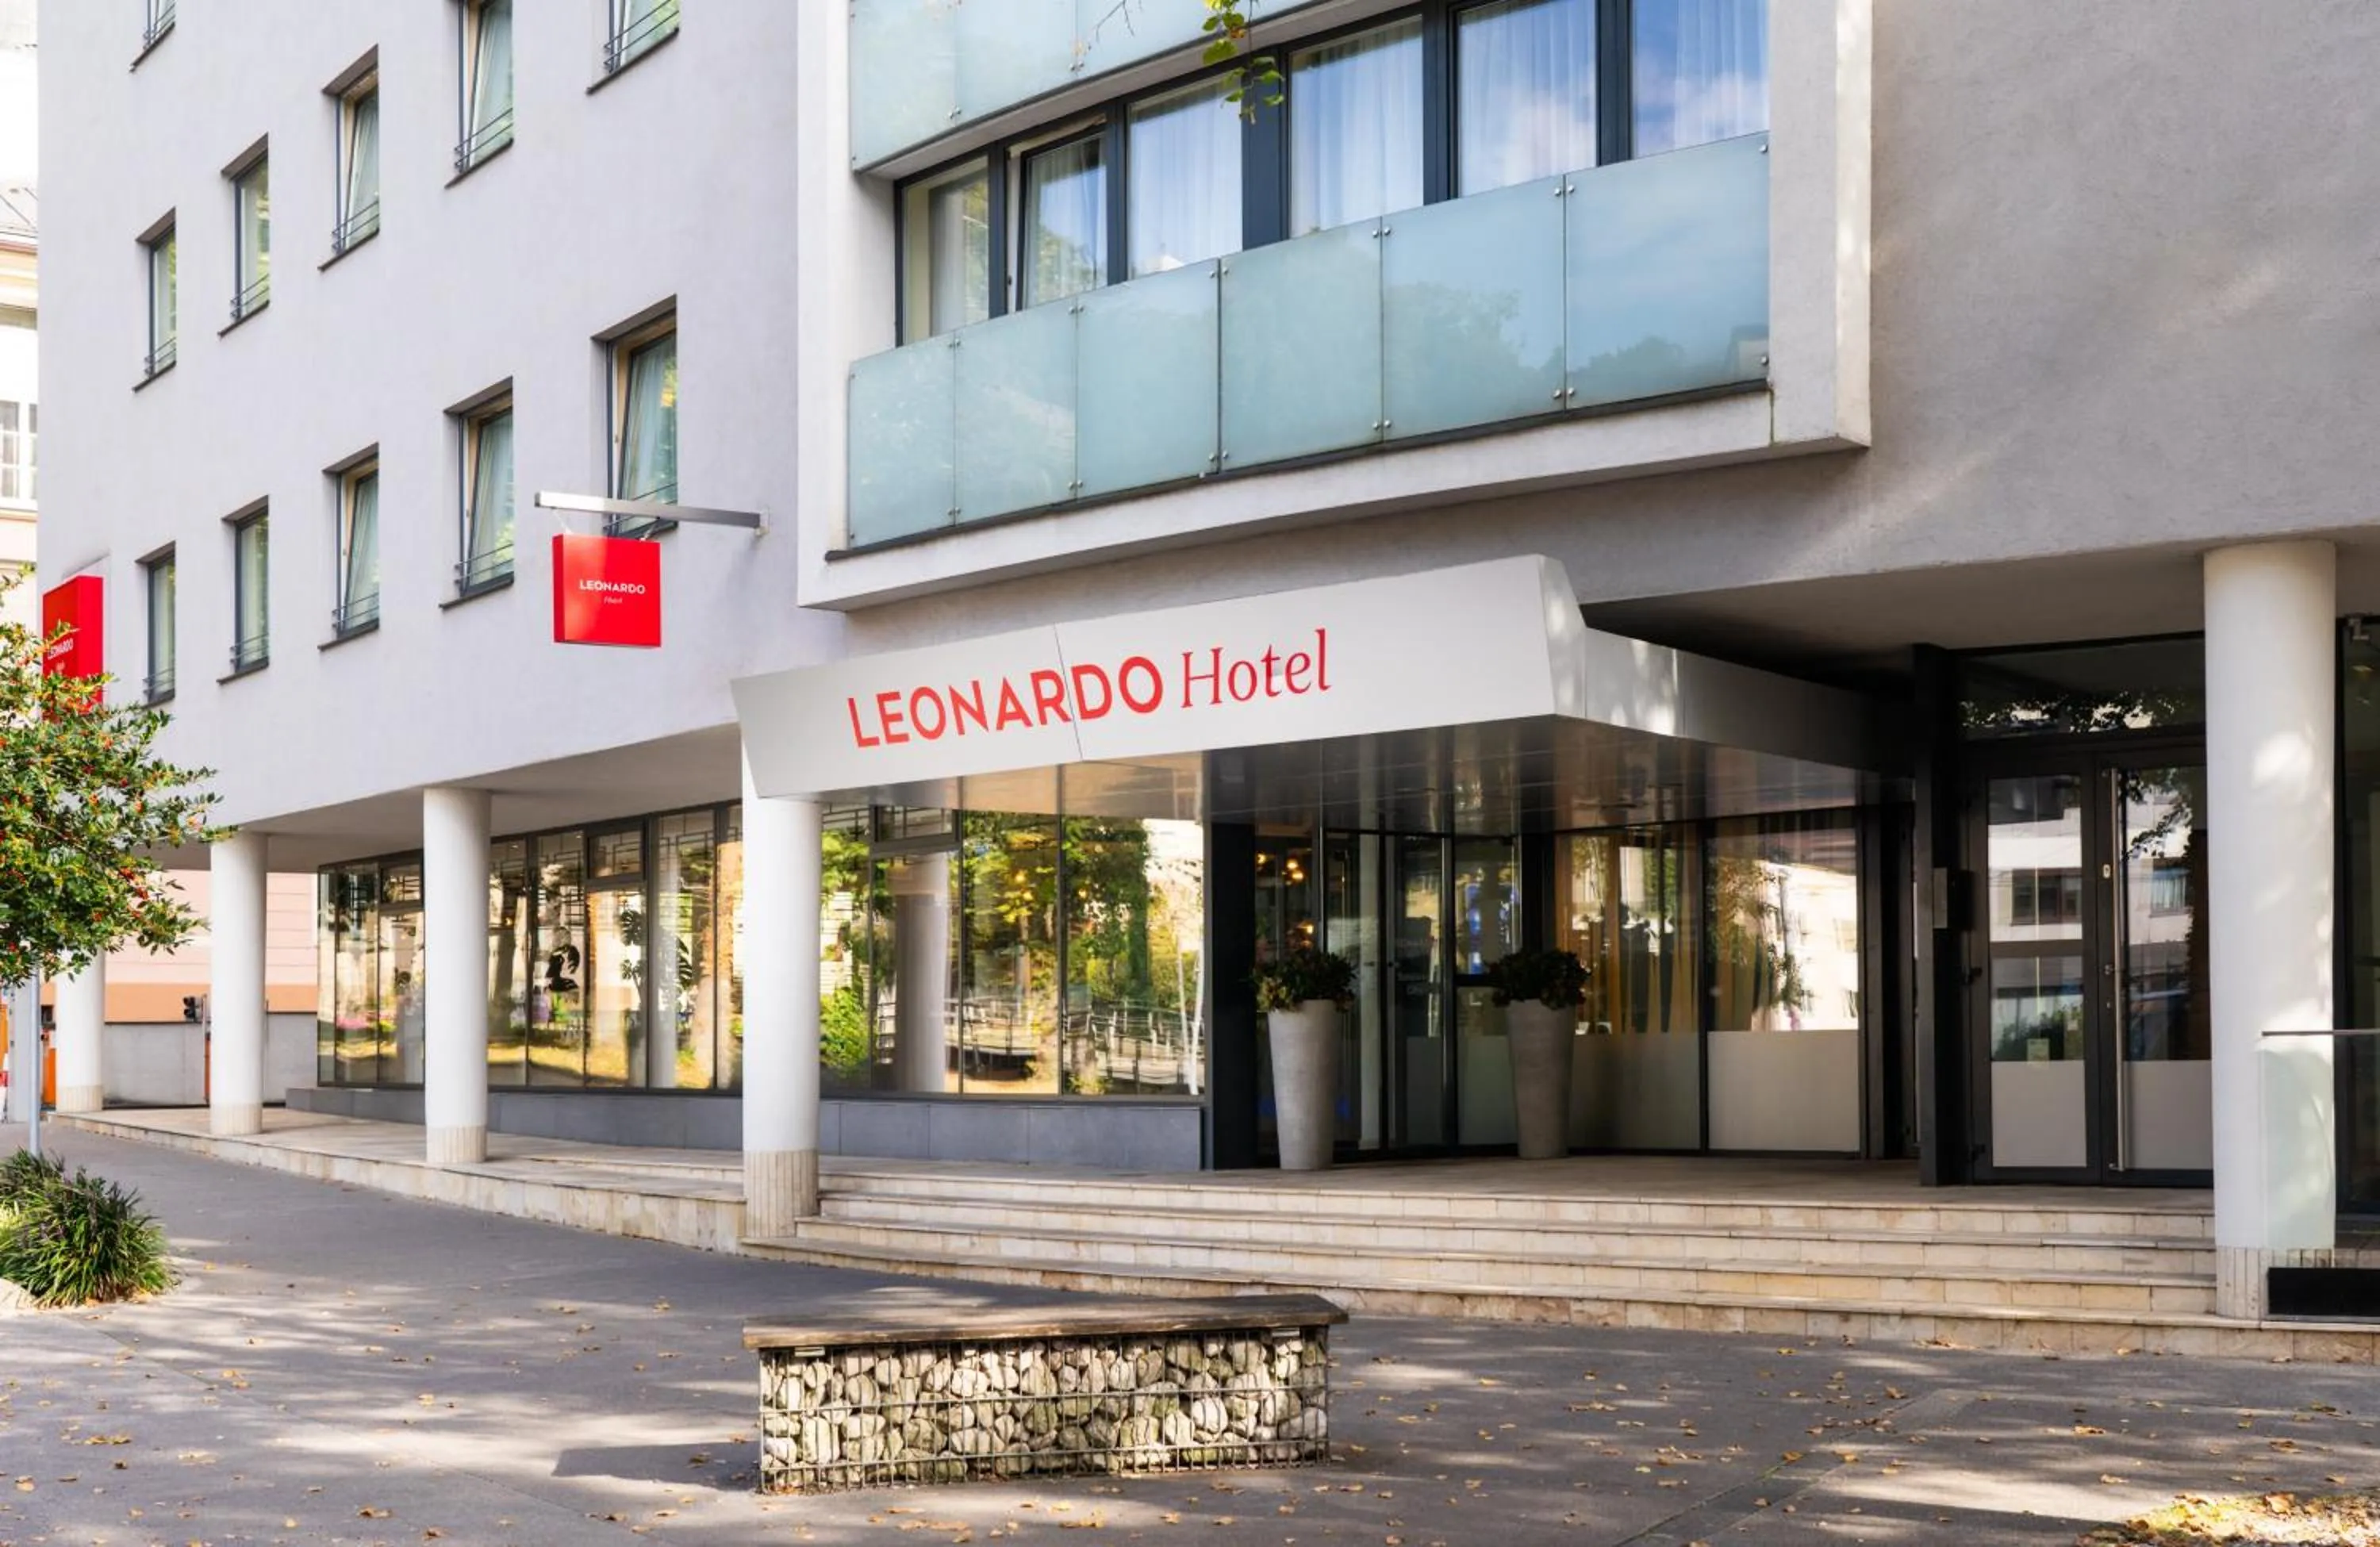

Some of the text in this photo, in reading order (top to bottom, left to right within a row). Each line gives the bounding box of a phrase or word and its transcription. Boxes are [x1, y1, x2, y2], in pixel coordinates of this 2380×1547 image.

[579, 580, 646, 594] LEONARDO
[847, 628, 1332, 748] LEONARDO Hotel
